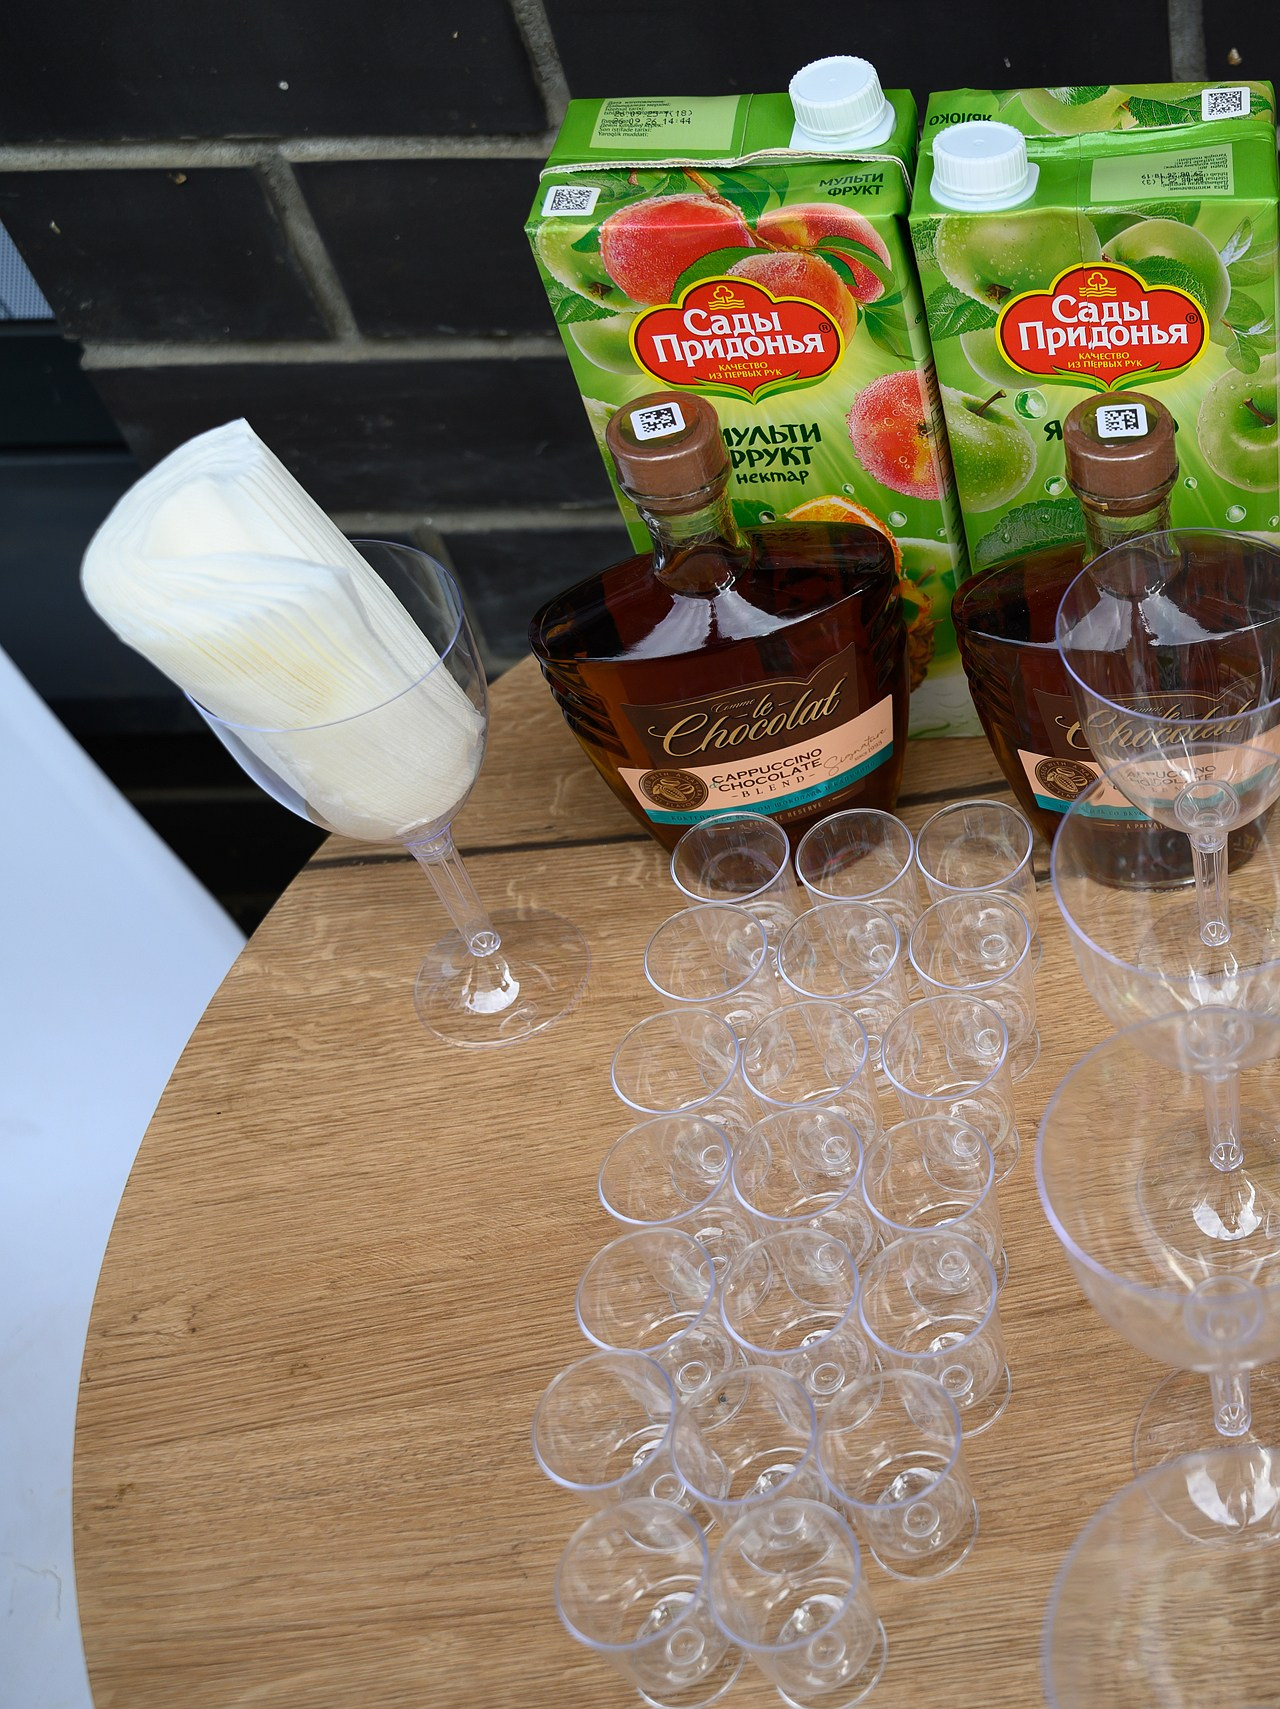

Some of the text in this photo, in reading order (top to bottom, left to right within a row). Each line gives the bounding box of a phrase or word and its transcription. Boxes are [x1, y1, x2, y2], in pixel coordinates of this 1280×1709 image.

[819, 173, 884, 187] МУЛЬТИ
[827, 184, 884, 197] ФРУКТ
[1051, 294, 1150, 325] Сады
[682, 308, 783, 337] Сады
[1017, 320, 1189, 356] Придонья
[651, 333, 826, 368] Придонья
[1078, 351, 1130, 361] КАЧЕСТВО
[718, 361, 768, 372] КАЧЕСТВО
[724, 370, 762, 379] ПЕРВЫХ
[763, 369, 783, 377] РУК
[1067, 359, 1143, 369] ИЗ ПЕРВЫХ РУК
[735, 470, 810, 485] нектар
[647, 673, 848, 757] Chocolat
[752, 691, 774, 719] le
[711, 748, 823, 784] CAPPUCCINO
[718, 757, 823, 792] CHOCOLATE
[740, 775, 806, 799] BLEND
[786, 803, 822, 818] RESERVE
